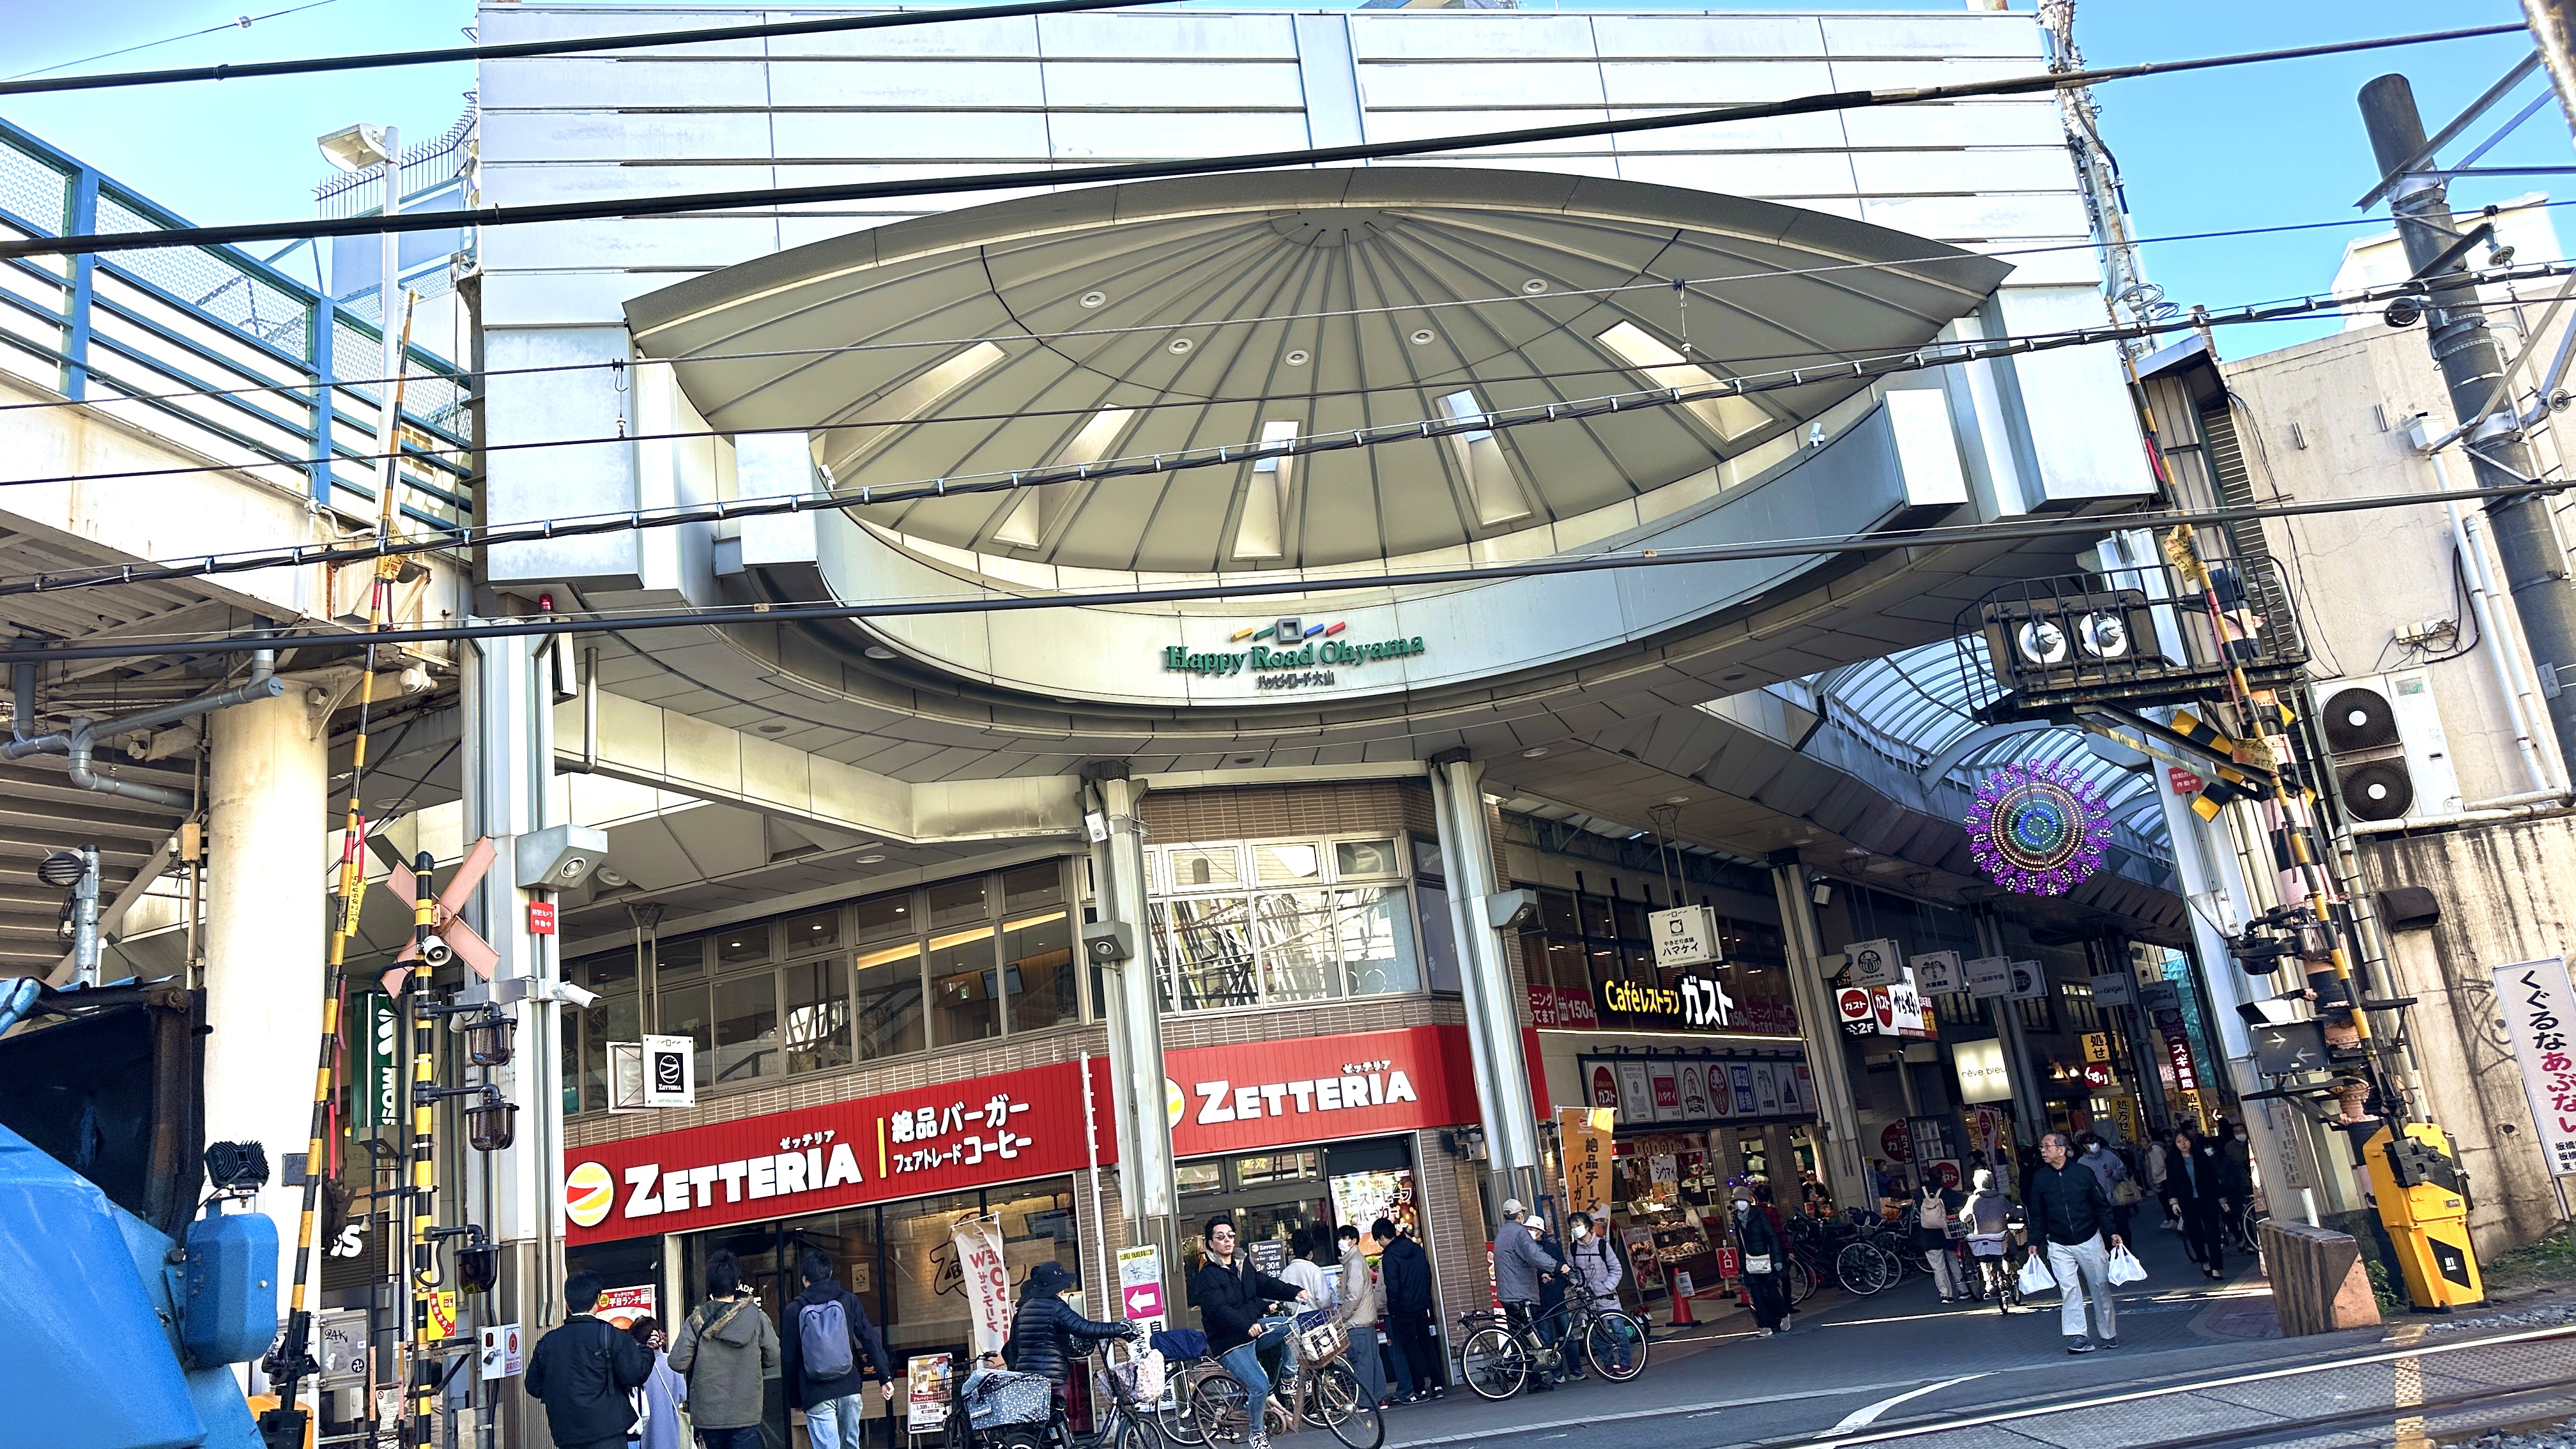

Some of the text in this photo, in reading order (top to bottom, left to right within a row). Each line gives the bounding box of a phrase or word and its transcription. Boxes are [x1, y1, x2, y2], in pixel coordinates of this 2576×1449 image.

[1166, 635, 1425, 678] Happy Road Ohyama
[1257, 670, 1335, 689] ハッピーロード大山
[2176, 779, 2197, 788] 作動中
[532, 908, 553, 917] 防犯カメラ
[1662, 942, 1698, 956] ハマケイ
[1664, 937, 1694, 946] やきとり本舗
[1681, 975, 1733, 1026] ガスト
[1844, 1000, 1867, 1011] ガスト
[1874, 994, 1890, 1011] ガスト
[1858, 1023, 1874, 1034] 2F
[1342, 1059, 1391, 1074] ゼッテリア
[2085, 1067, 2108, 1084] くすり
[2173, 1043, 2194, 1089] スギ薬局
[1195, 1071, 1417, 1125] ZETTERIA
[1598, 1089, 1616, 1104] ガスト
[891, 1092, 1031, 1144] 絶品バーガー
[2117, 1100, 2131, 1142] 処方せん
[780, 1130, 836, 1150] ゼッテリア
[624, 1142, 863, 1218] ZETTERIA
[1585, 1137, 1600, 1213] 絶品チーズ
[1572, 1162, 1583, 1211] バーガー
[1722, 1250, 1733, 1269] 入口
[609, 1296, 641, 1307] 平日ランチ
[431, 1298, 454, 1334] 非常ボタン
